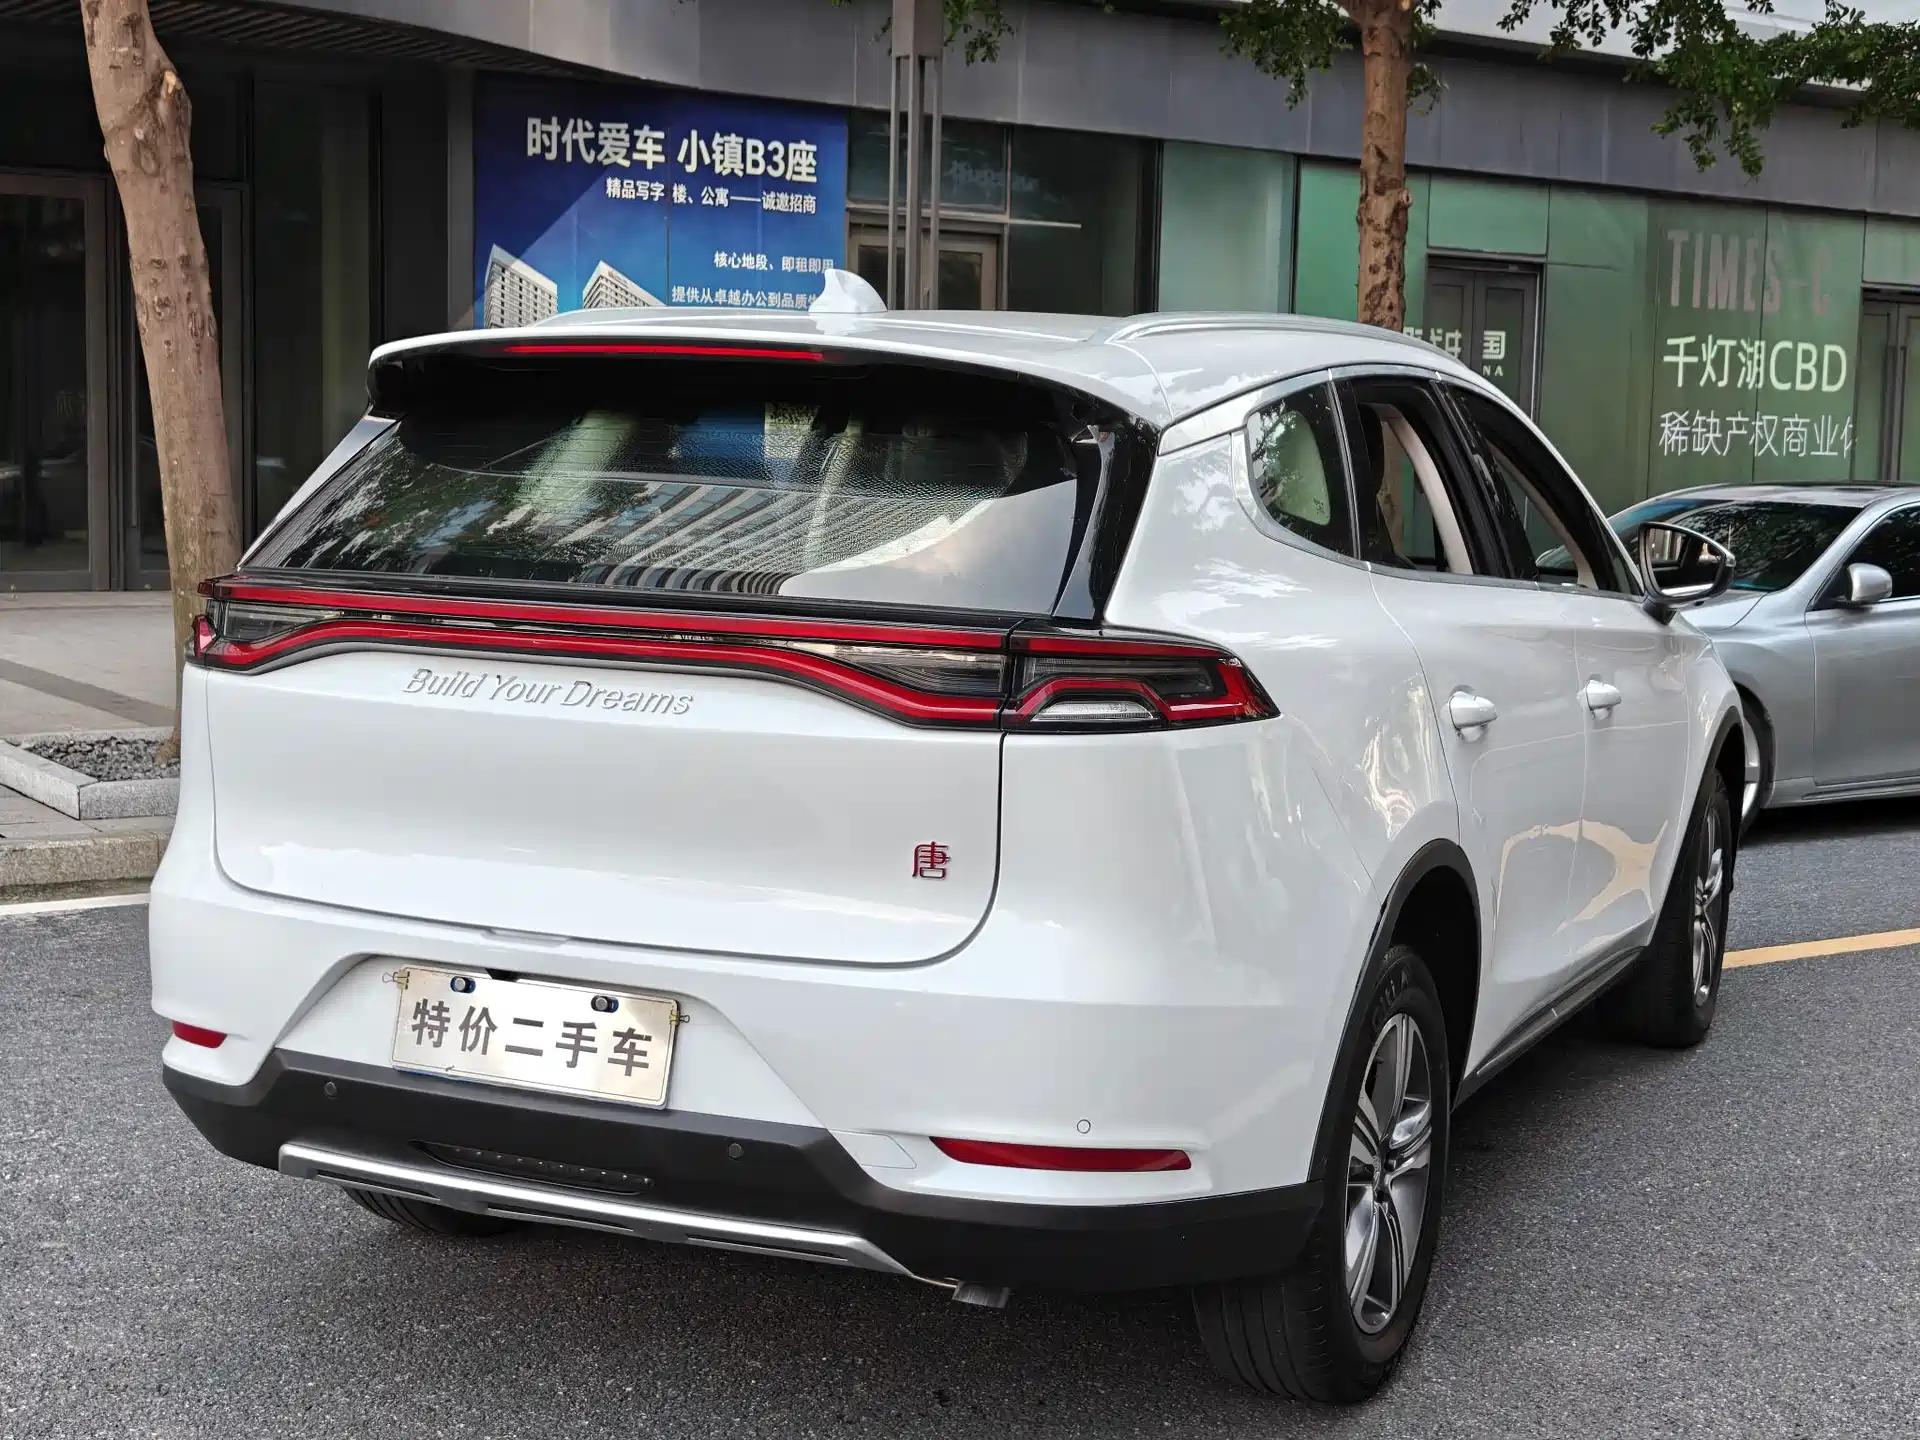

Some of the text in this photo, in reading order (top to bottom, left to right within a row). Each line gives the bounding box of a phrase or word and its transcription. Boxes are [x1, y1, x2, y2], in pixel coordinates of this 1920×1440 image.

[526, 116, 818, 183] 时代爱车 小镇B3座
[606, 177, 665, 201] 精品写字
[1663, 334, 1847, 393] 千灯湖CBD
[403, 667, 694, 715] Build Your Dreams
[912, 841, 951, 880] 唐
[412, 998, 652, 1077] 特价二手车
